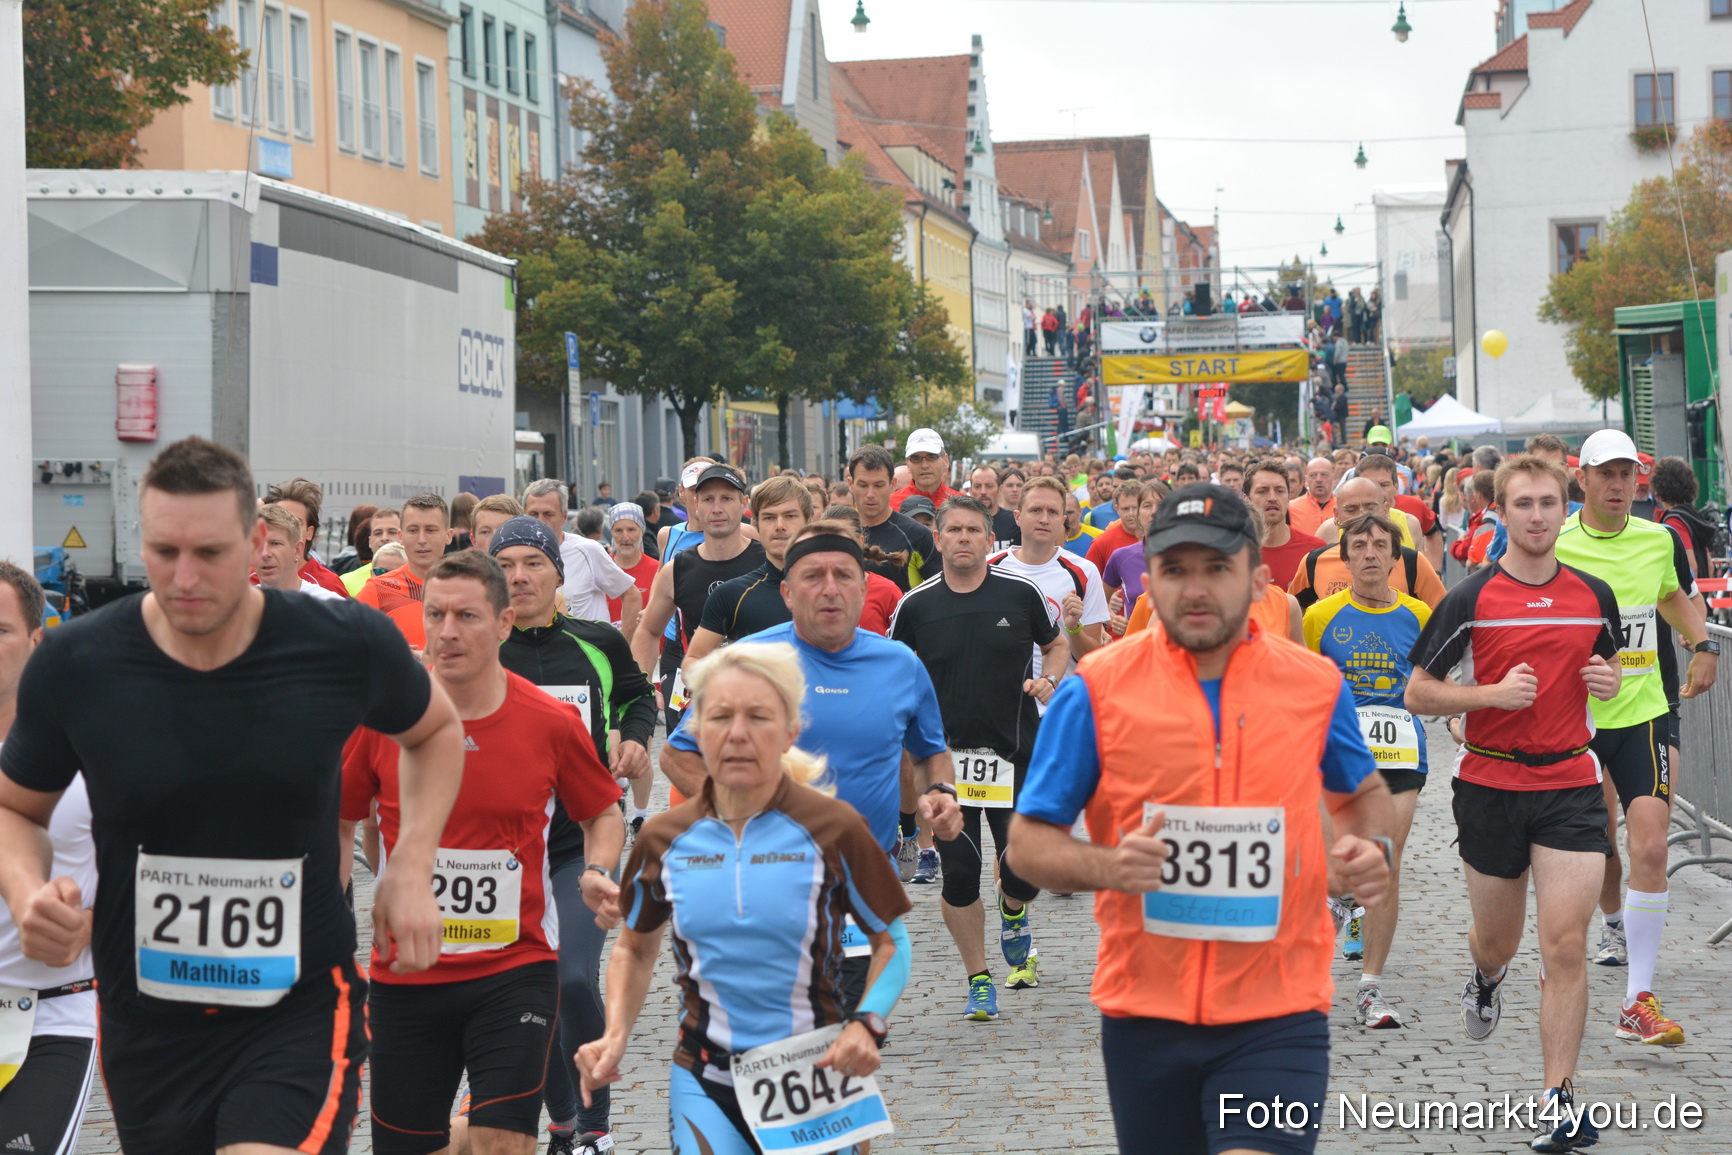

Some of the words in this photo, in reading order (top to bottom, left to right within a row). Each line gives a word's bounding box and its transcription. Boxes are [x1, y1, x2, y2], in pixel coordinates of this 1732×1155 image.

[459, 330, 504, 397] BOCK
[1170, 358, 1240, 377] START
[381, 580, 401, 590] adidas
[1619, 612, 1647, 621] Neumarkt
[1621, 622, 1646, 648] 17
[1619, 655, 1646, 667] istoph
[1371, 711, 1402, 720] Neumarkt
[1369, 720, 1396, 744] 40
[1370, 750, 1401, 760] erbert
[1658, 743, 1668, 784] SKINS
[958, 756, 999, 782] 191
[967, 787, 986, 798] Uwe
[1195, 820, 1263, 834] Neumarkt
[446, 859, 502, 871] Neumarkt
[1161, 838, 1271, 889] 3313
[140, 869, 194, 886] PARTL
[198, 873, 274, 889] Neumarkt
[1166, 896, 1255, 925] Stefan
[153, 893, 284, 949] 2169
[441, 924, 491, 940] atthias
[170, 960, 261, 985] Matthias
[532, 1015, 547, 1026] asics
[734, 1057, 779, 1077] PARTL
[780, 1040, 832, 1064] Neumark
[790, 1115, 853, 1145] Marion
[6, 1142, 35, 1152] adidas
